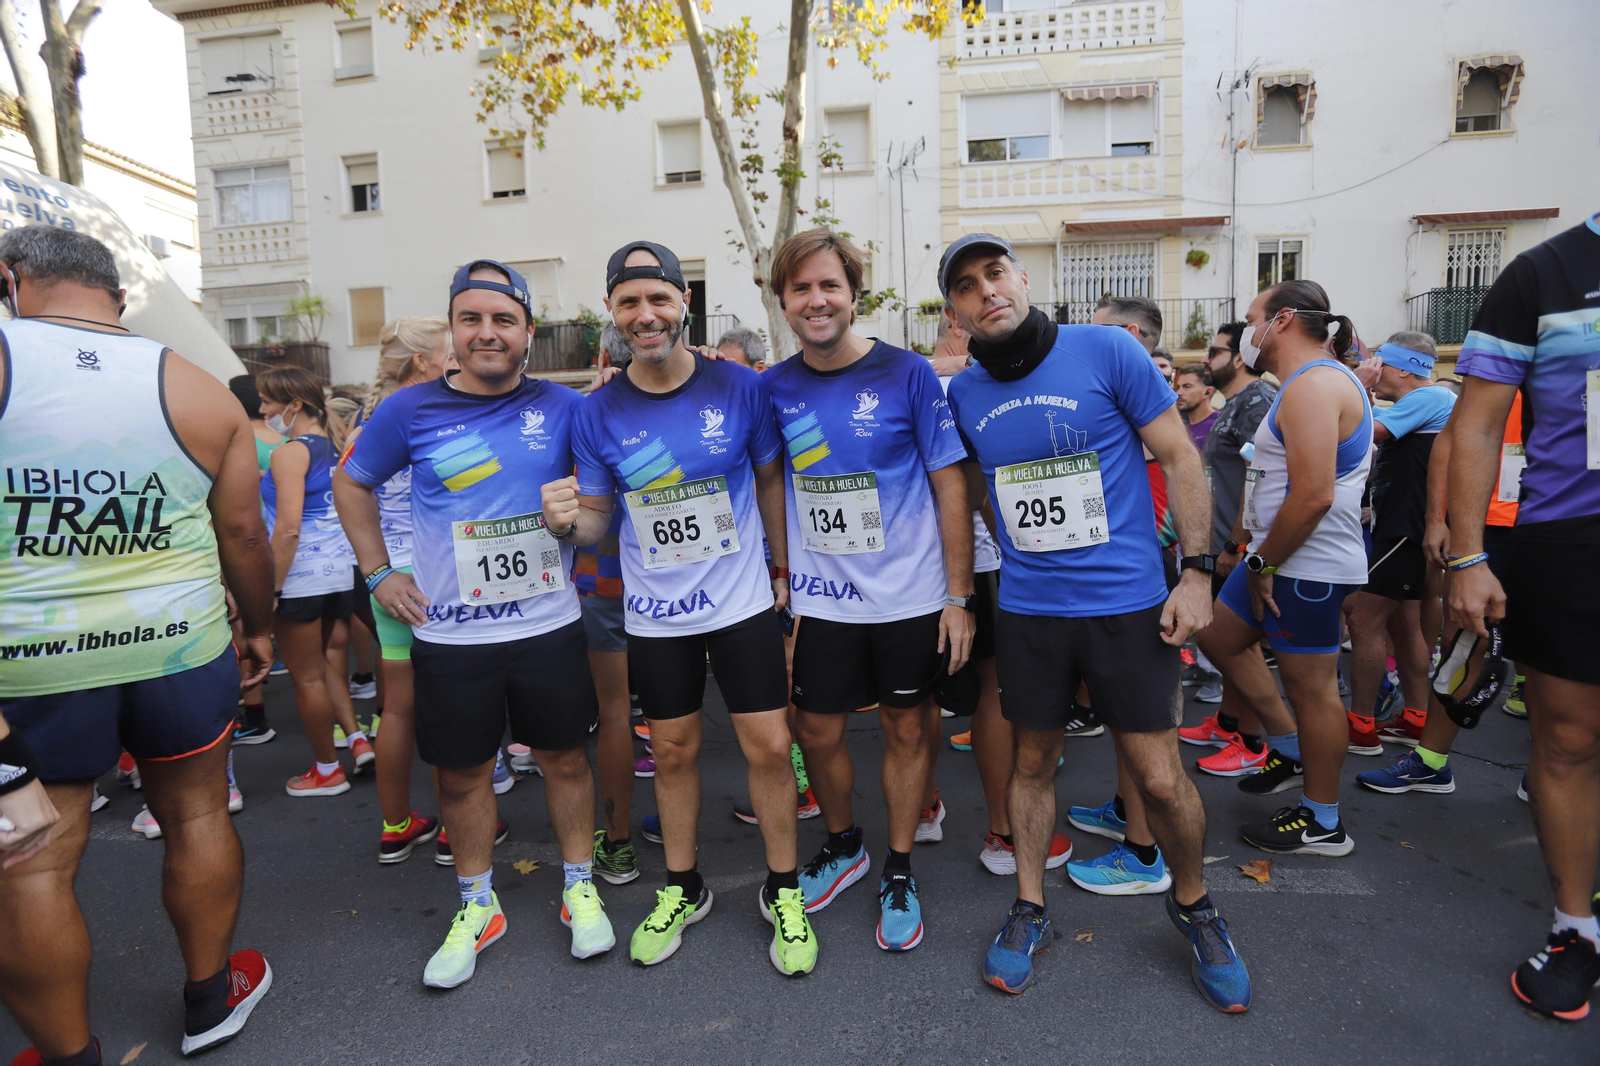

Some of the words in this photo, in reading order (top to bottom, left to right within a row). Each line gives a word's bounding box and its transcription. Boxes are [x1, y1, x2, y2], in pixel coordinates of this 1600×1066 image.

[988, 398, 1022, 420] VUELTA
[1023, 396, 1032, 406] A
[1033, 394, 1079, 411] HUELVA
[1510, 446, 1520, 455] 34
[7, 468, 167, 496] IBHOLA
[1001, 471, 1012, 483] 34
[1014, 466, 1044, 481] VUELTA
[1045, 465, 1053, 477] A
[1054, 458, 1091, 475] HUELVA
[679, 488, 686, 499] A
[804, 480, 827, 491] VUELTA
[829, 481, 836, 491] A
[837, 477, 869, 490] HUELVA
[3, 496, 172, 535] TRAIL
[809, 507, 847, 533] 134
[1015, 496, 1066, 528] 295
[474, 523, 508, 537] VUELTA
[511, 521, 517, 533] A
[477, 537, 514, 547] EDUARDO
[652, 515, 701, 545] 685
[17, 531, 171, 557] RUNNING
[477, 550, 528, 582] 136
[0, 620, 189, 660] www.ibhola.es
